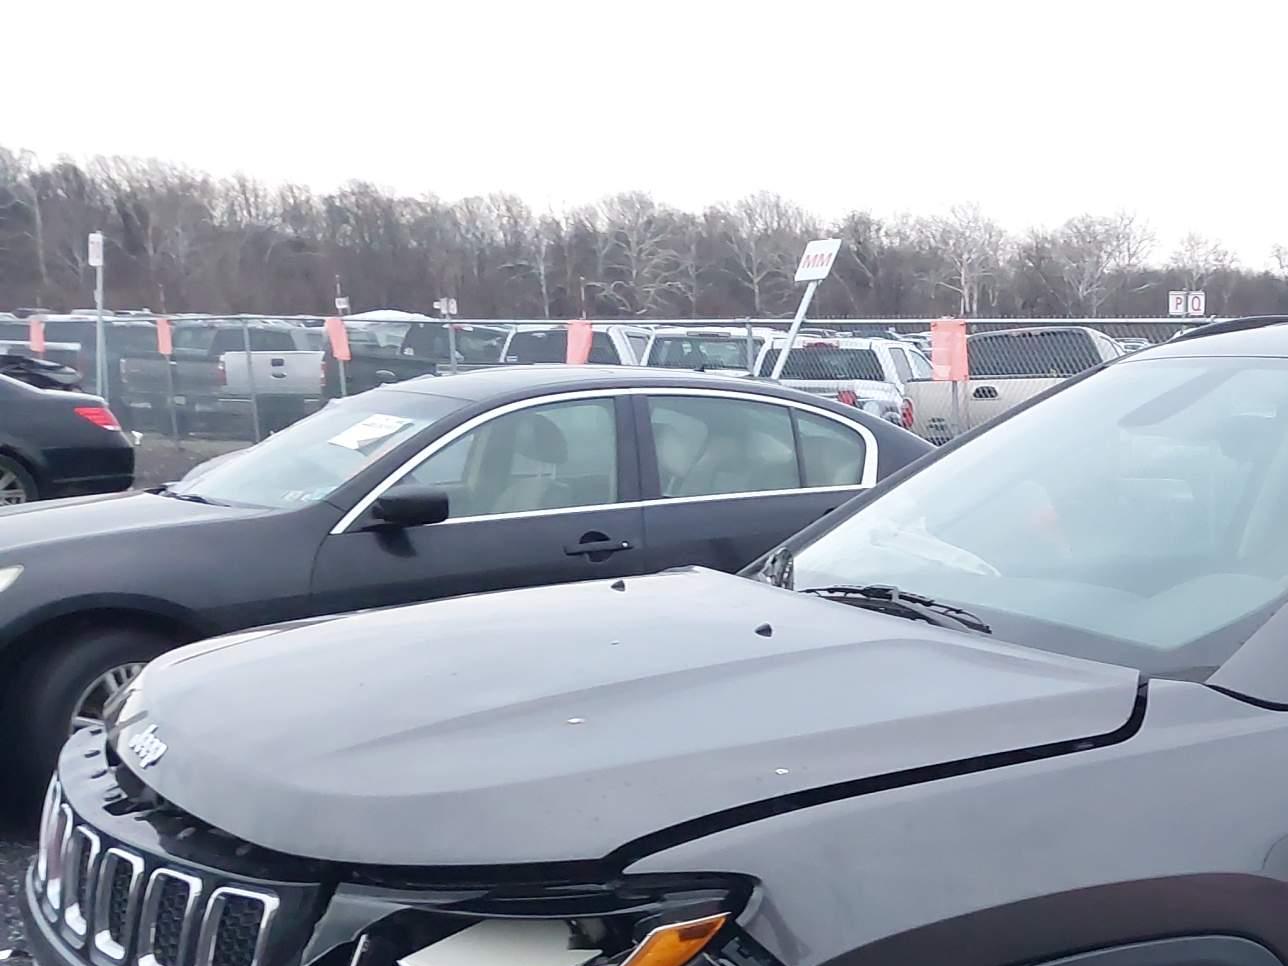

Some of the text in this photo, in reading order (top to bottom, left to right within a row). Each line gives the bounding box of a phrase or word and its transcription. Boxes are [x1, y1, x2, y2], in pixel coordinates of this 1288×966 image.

[801, 252, 833, 268] MM
[1175, 296, 1183, 311] P
[1191, 295, 1202, 312] Q
